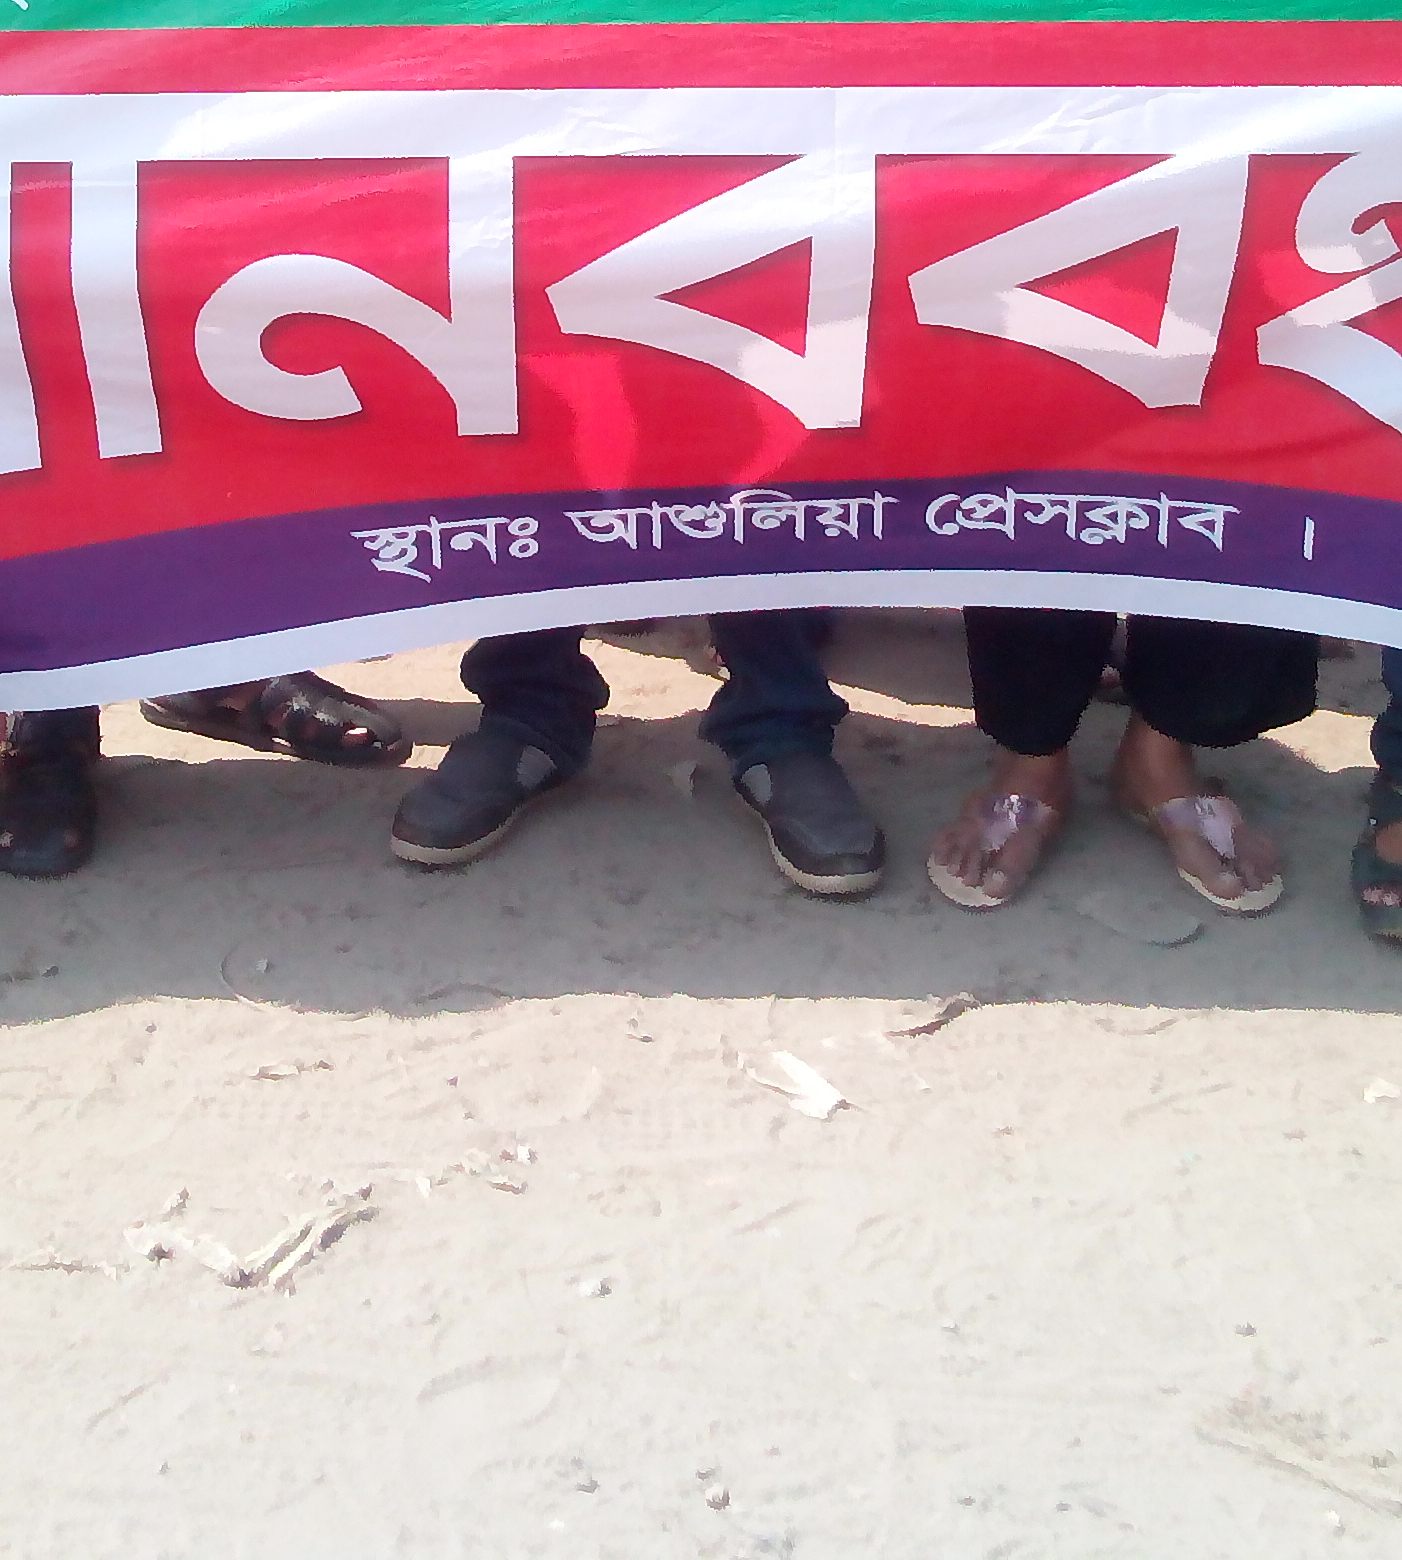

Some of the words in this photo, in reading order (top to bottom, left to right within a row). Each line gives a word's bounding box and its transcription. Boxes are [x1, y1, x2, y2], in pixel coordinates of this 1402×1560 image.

[349, 514, 540, 584] স্থানঃ
[563, 487, 899, 550] আশুলিয়া
[924, 489, 1241, 552] প্রেসক্লাব
